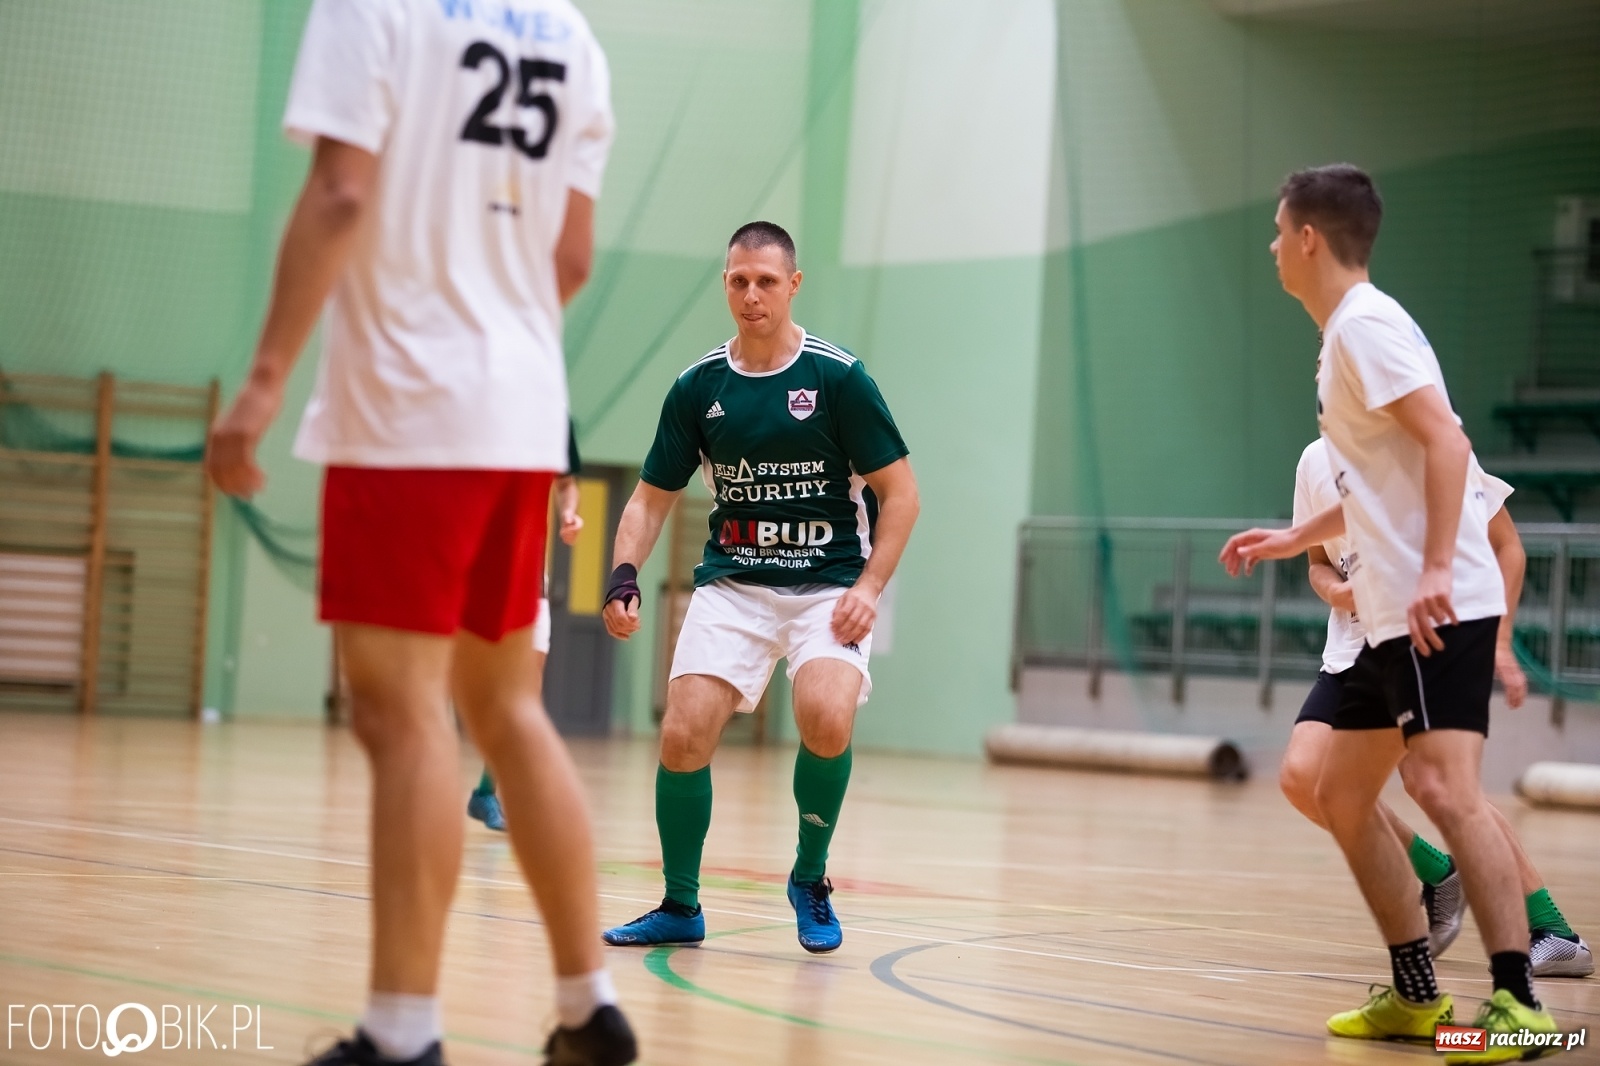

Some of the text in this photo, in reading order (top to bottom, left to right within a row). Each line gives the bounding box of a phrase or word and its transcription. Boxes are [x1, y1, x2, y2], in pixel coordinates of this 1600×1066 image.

[460, 41, 566, 160] 25
[706, 410, 725, 419] adidas
[719, 480, 830, 502] ECURITY
[759, 546, 826, 558] BRUKARSKIE
[732, 555, 811, 569] PIOTR BADURA
